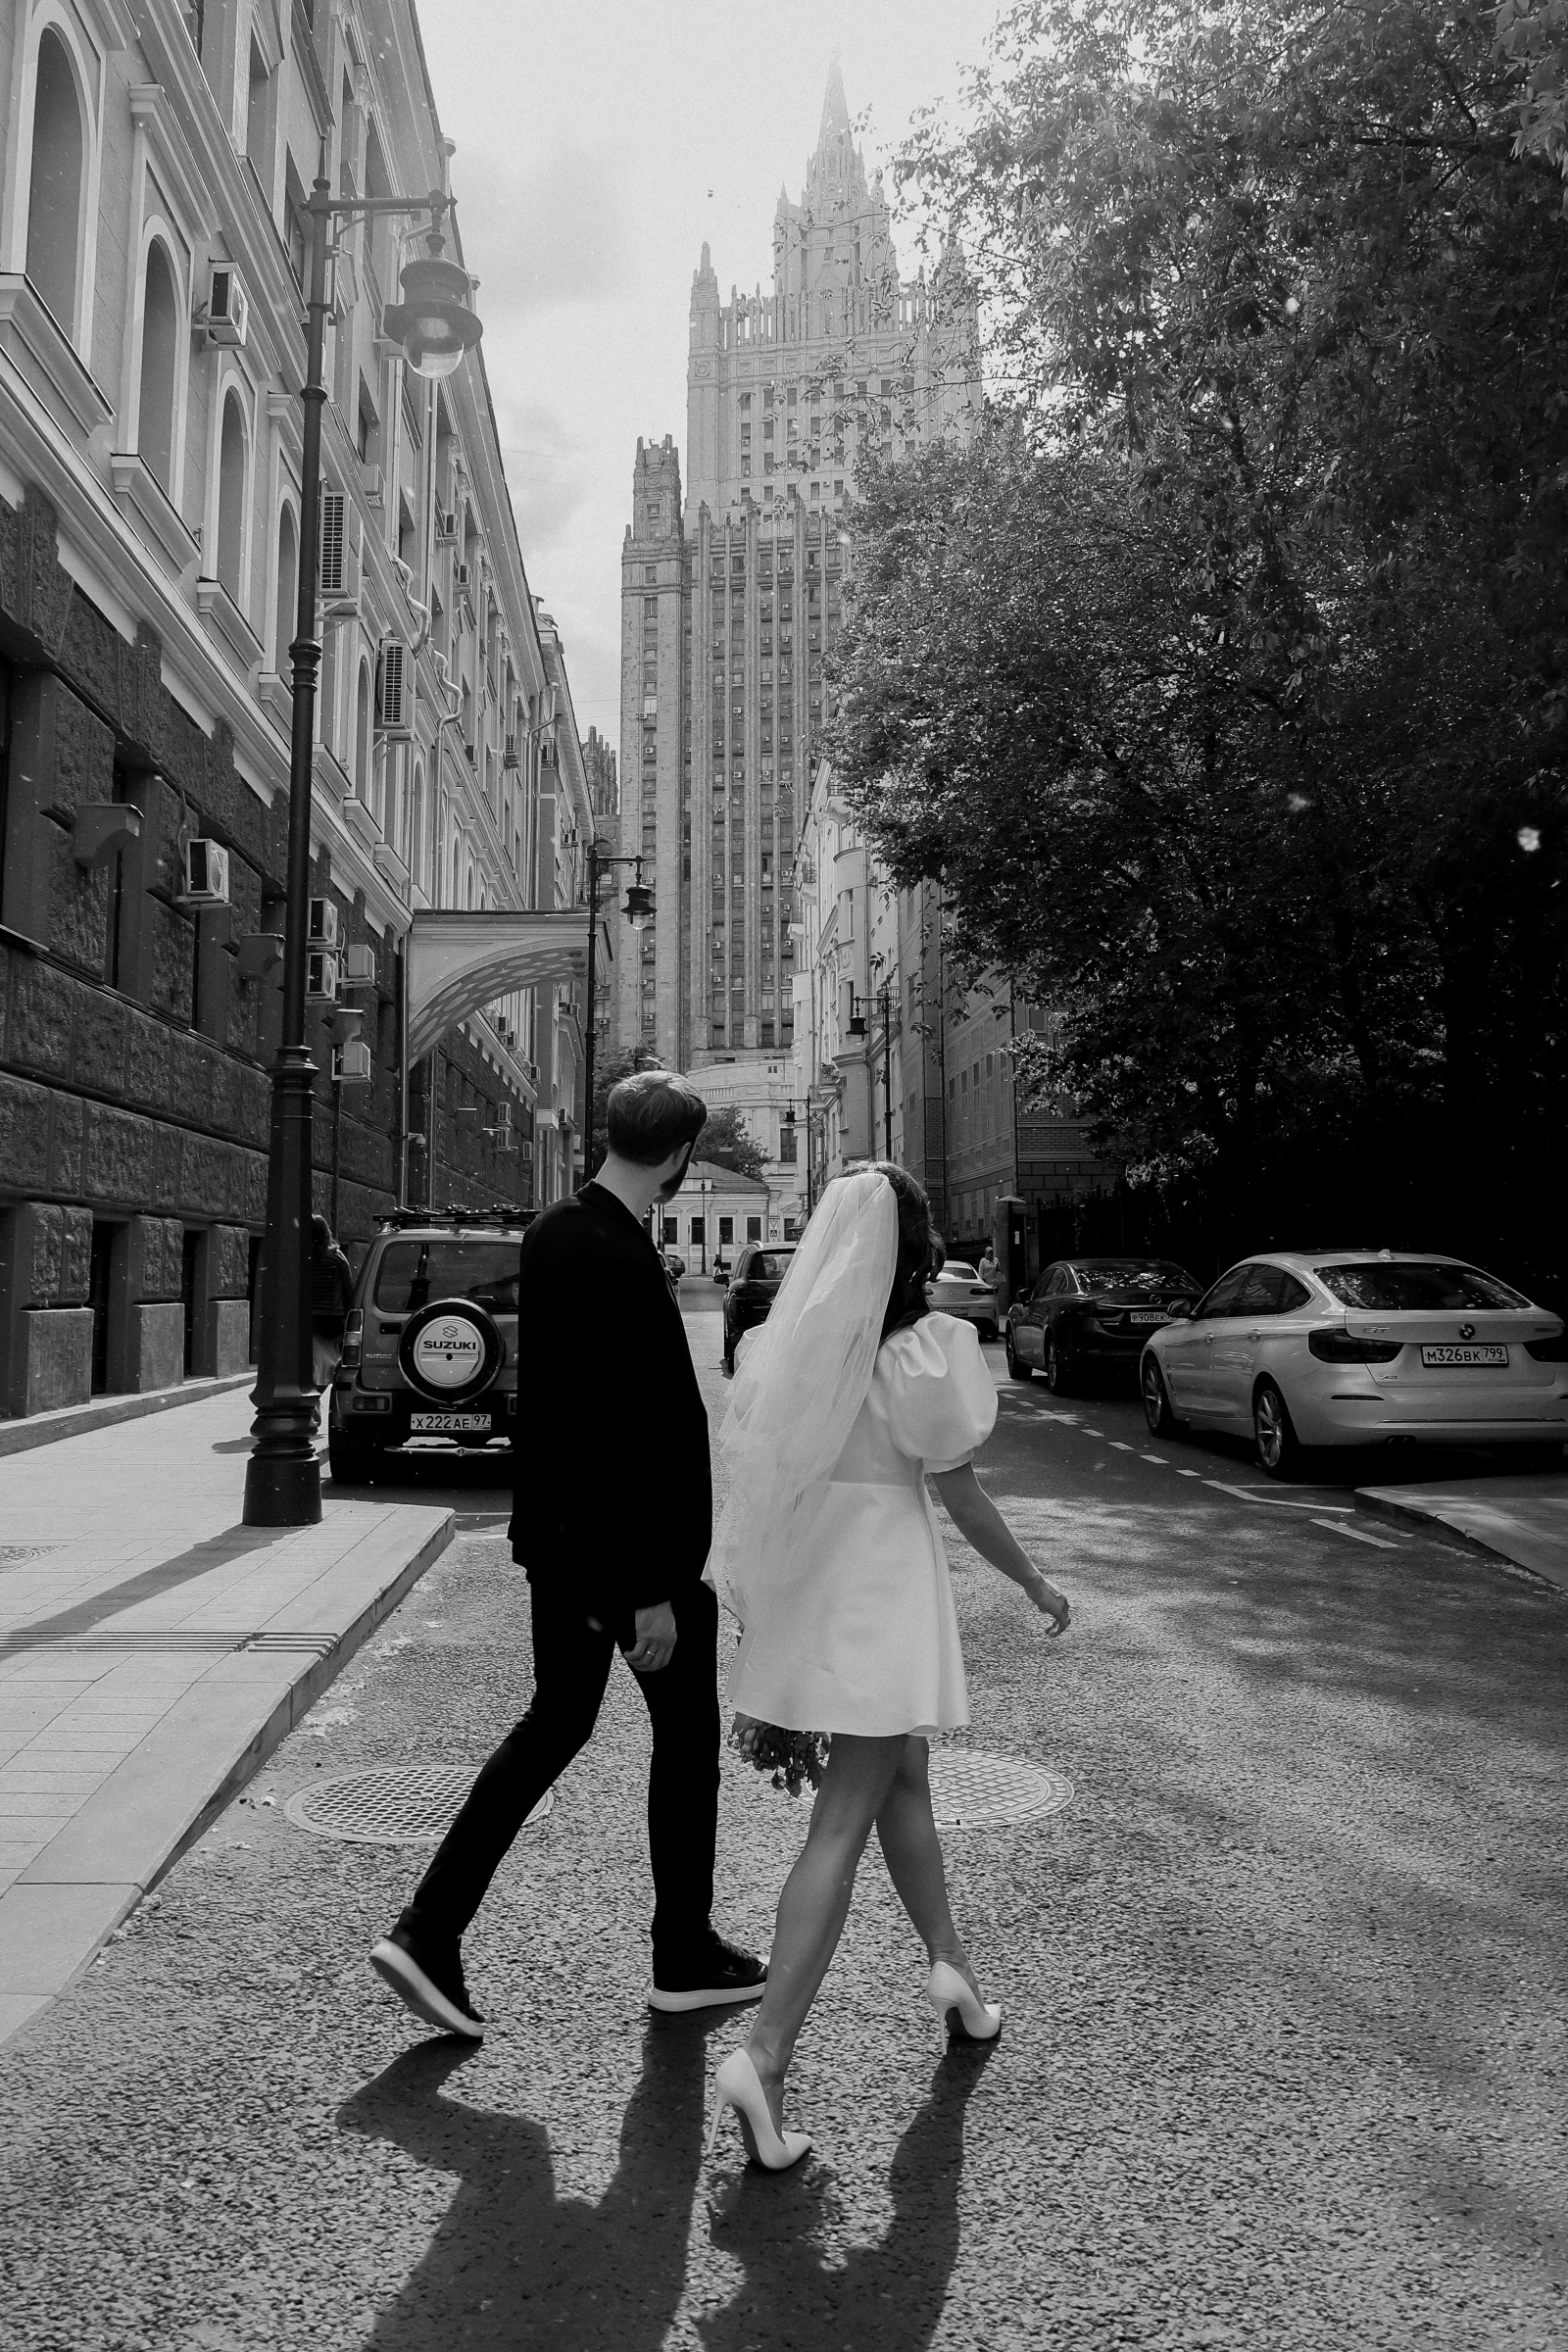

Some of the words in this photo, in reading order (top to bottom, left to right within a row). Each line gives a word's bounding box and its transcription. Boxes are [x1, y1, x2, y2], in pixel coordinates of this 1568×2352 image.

[423, 1340, 476, 1350] SUZUKI
[1427, 1348, 1482, 1362] М326ВК
[1482, 1348, 1503, 1358] 799
[416, 1415, 470, 1430] Х222АЕ
[473, 1415, 488, 1425] 97
